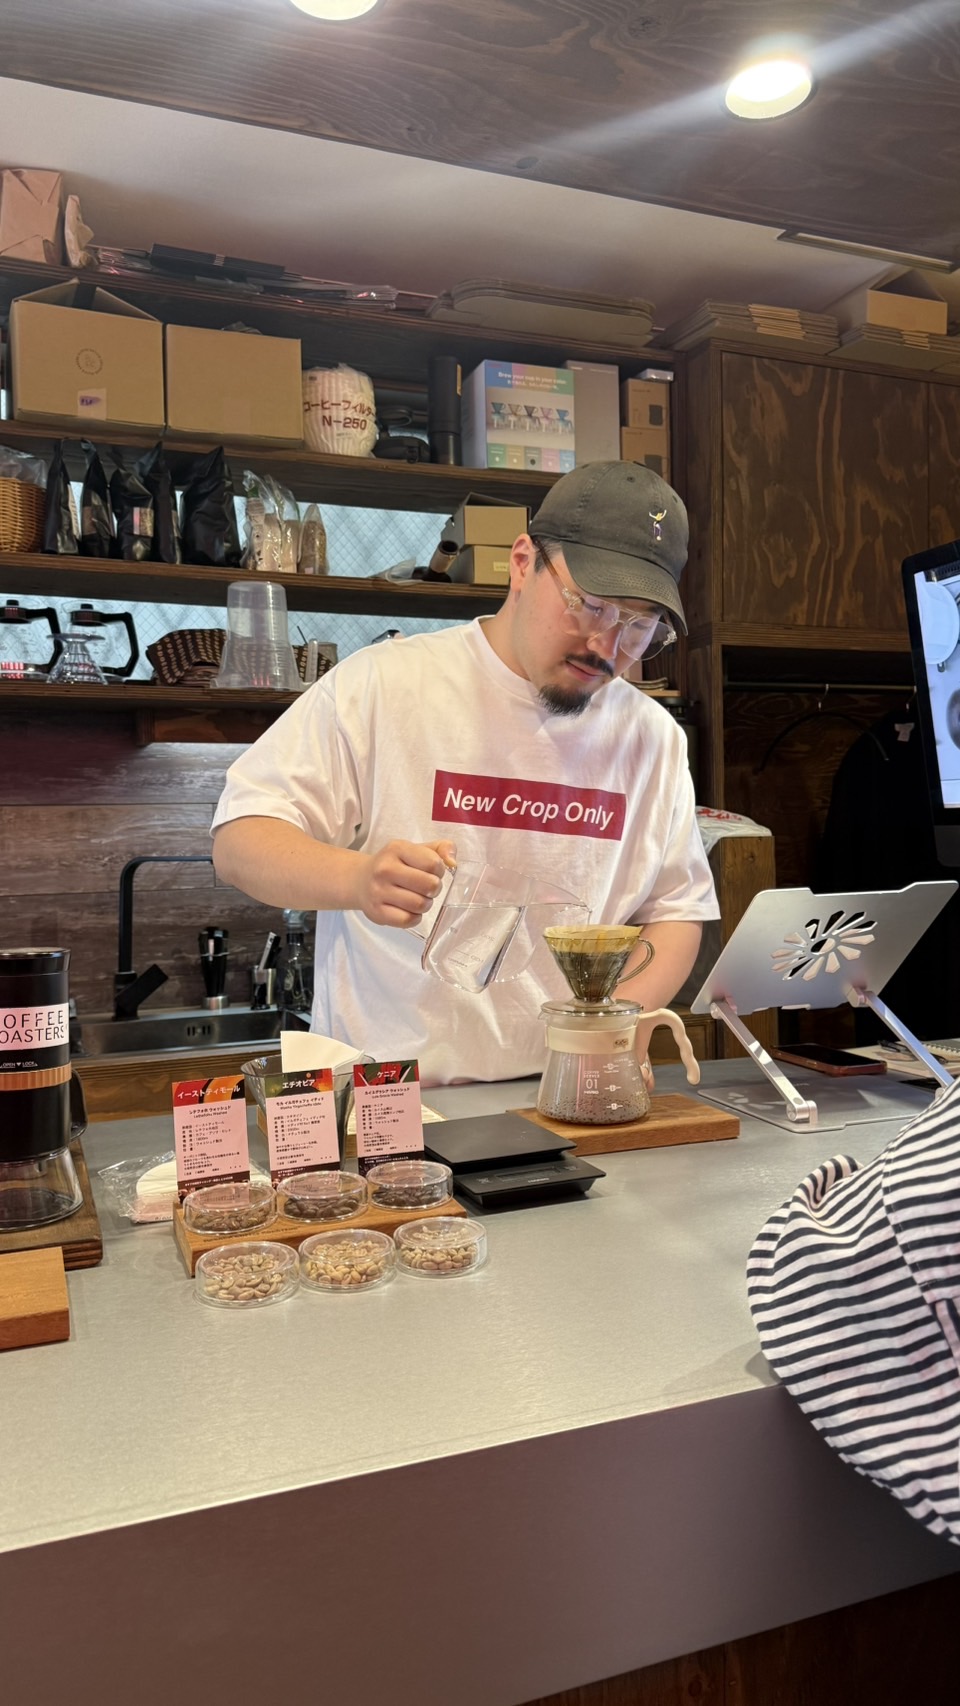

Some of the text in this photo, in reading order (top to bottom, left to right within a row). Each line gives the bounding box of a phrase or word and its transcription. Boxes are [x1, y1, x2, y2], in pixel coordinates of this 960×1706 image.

[303, 399, 376, 417] コーヒーフィルター
[443, 787, 615, 831] New Crop Only
[3, 1010, 64, 1029] OFFEE
[0, 1025, 65, 1044] OASTERS
[377, 1070, 397, 1078] ケニア
[282, 1079, 316, 1090] エチオピア
[585, 1078, 598, 1089] 01
[177, 1085, 241, 1099] イーストティモール
